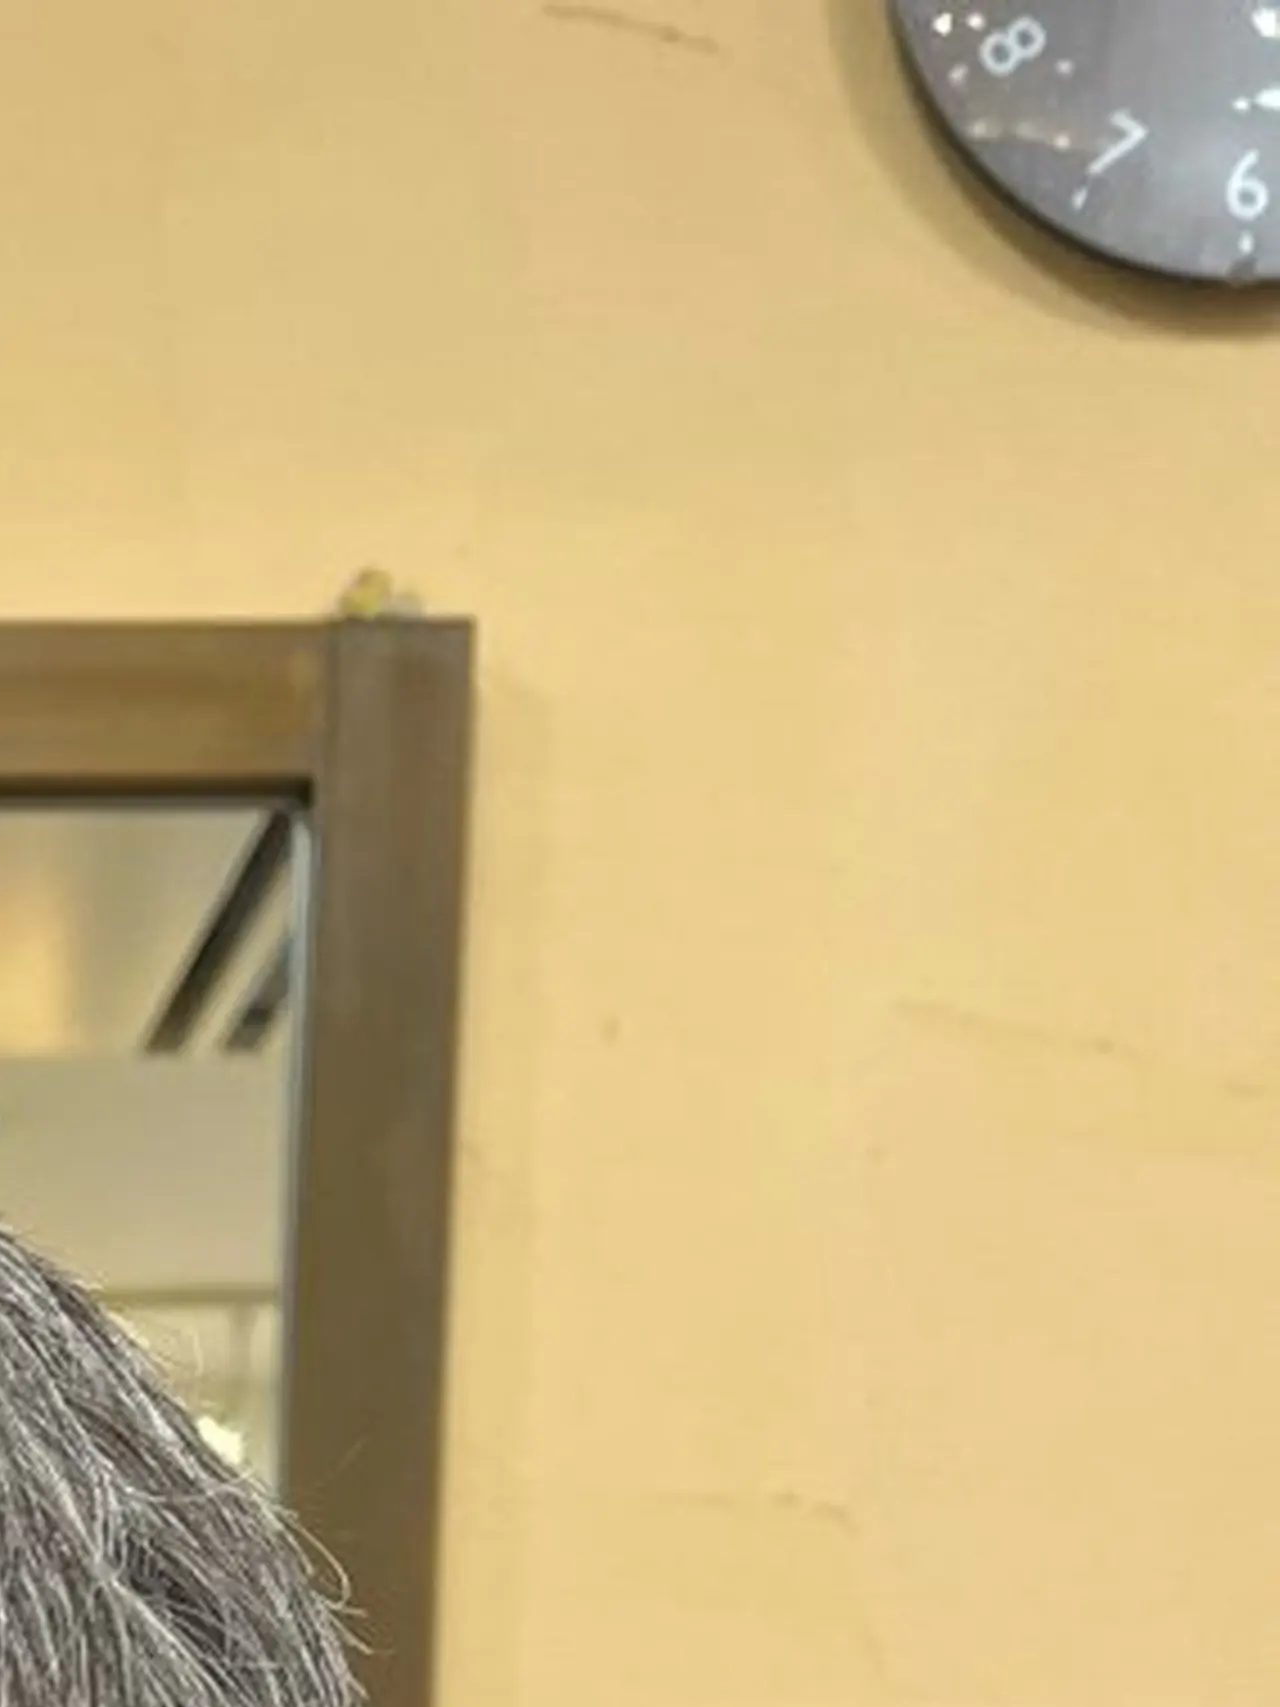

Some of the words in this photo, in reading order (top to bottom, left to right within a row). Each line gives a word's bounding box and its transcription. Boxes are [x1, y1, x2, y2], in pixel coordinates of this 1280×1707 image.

[979, 14, 1048, 77] 8
[1086, 106, 1151, 178] 7
[1225, 148, 1271, 221] 6
